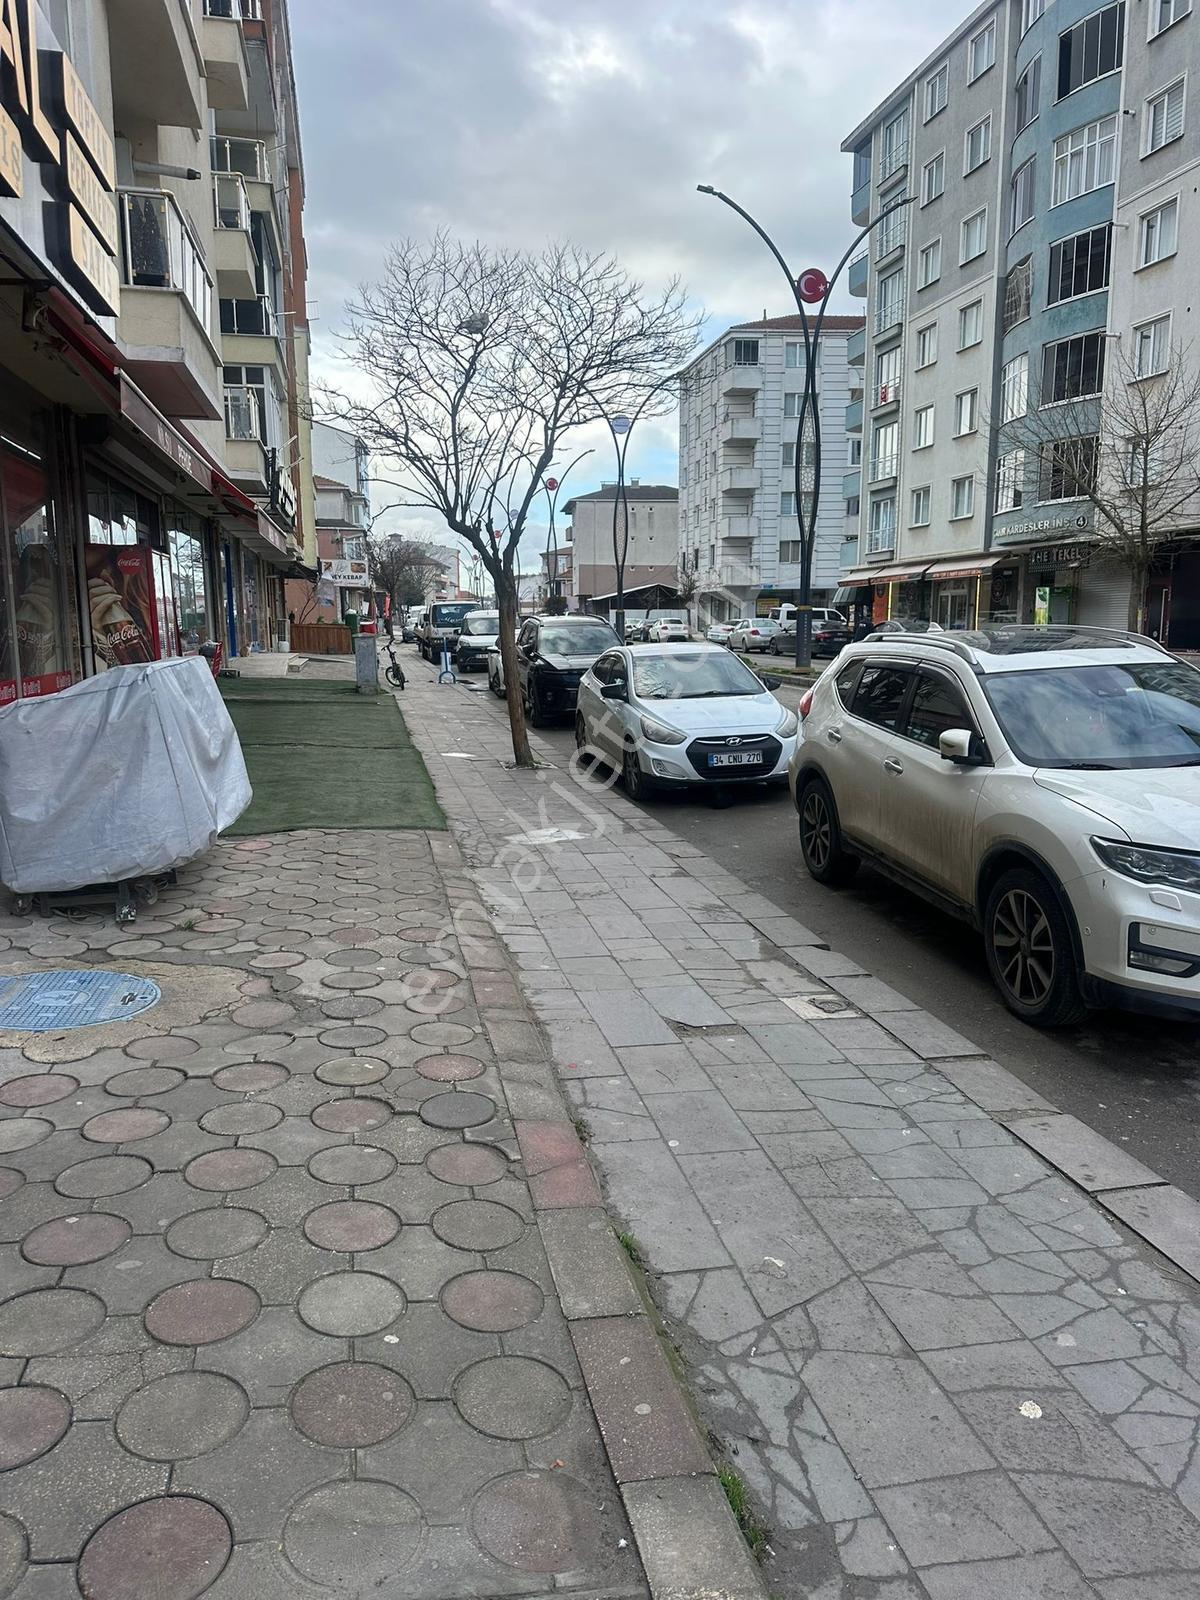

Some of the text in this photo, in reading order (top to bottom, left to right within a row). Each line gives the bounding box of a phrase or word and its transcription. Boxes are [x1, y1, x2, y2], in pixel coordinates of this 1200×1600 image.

[714, 753, 760, 764] 34 CNU 270
